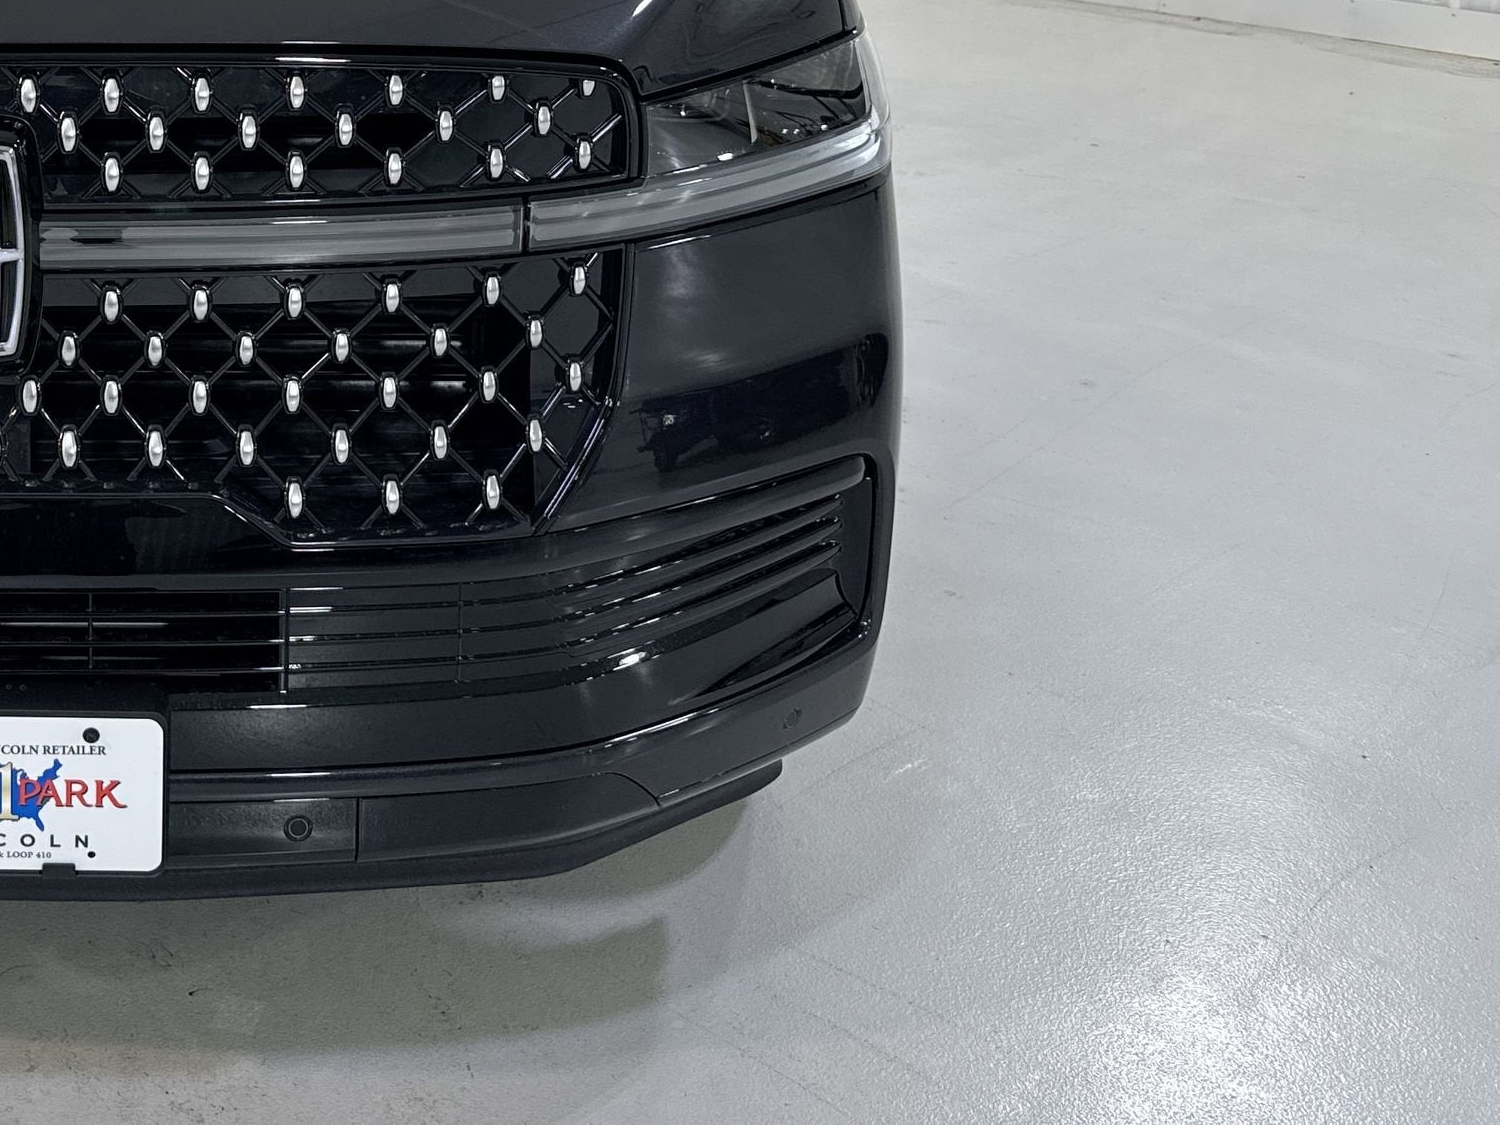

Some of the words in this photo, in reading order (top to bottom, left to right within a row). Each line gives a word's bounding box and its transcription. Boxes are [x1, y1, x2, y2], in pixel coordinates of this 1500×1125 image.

[42, 744, 106, 756] RETAILER
[18, 777, 128, 809] PARK
[6, 850, 34, 859] LOOP
[35, 850, 52, 859] 410
